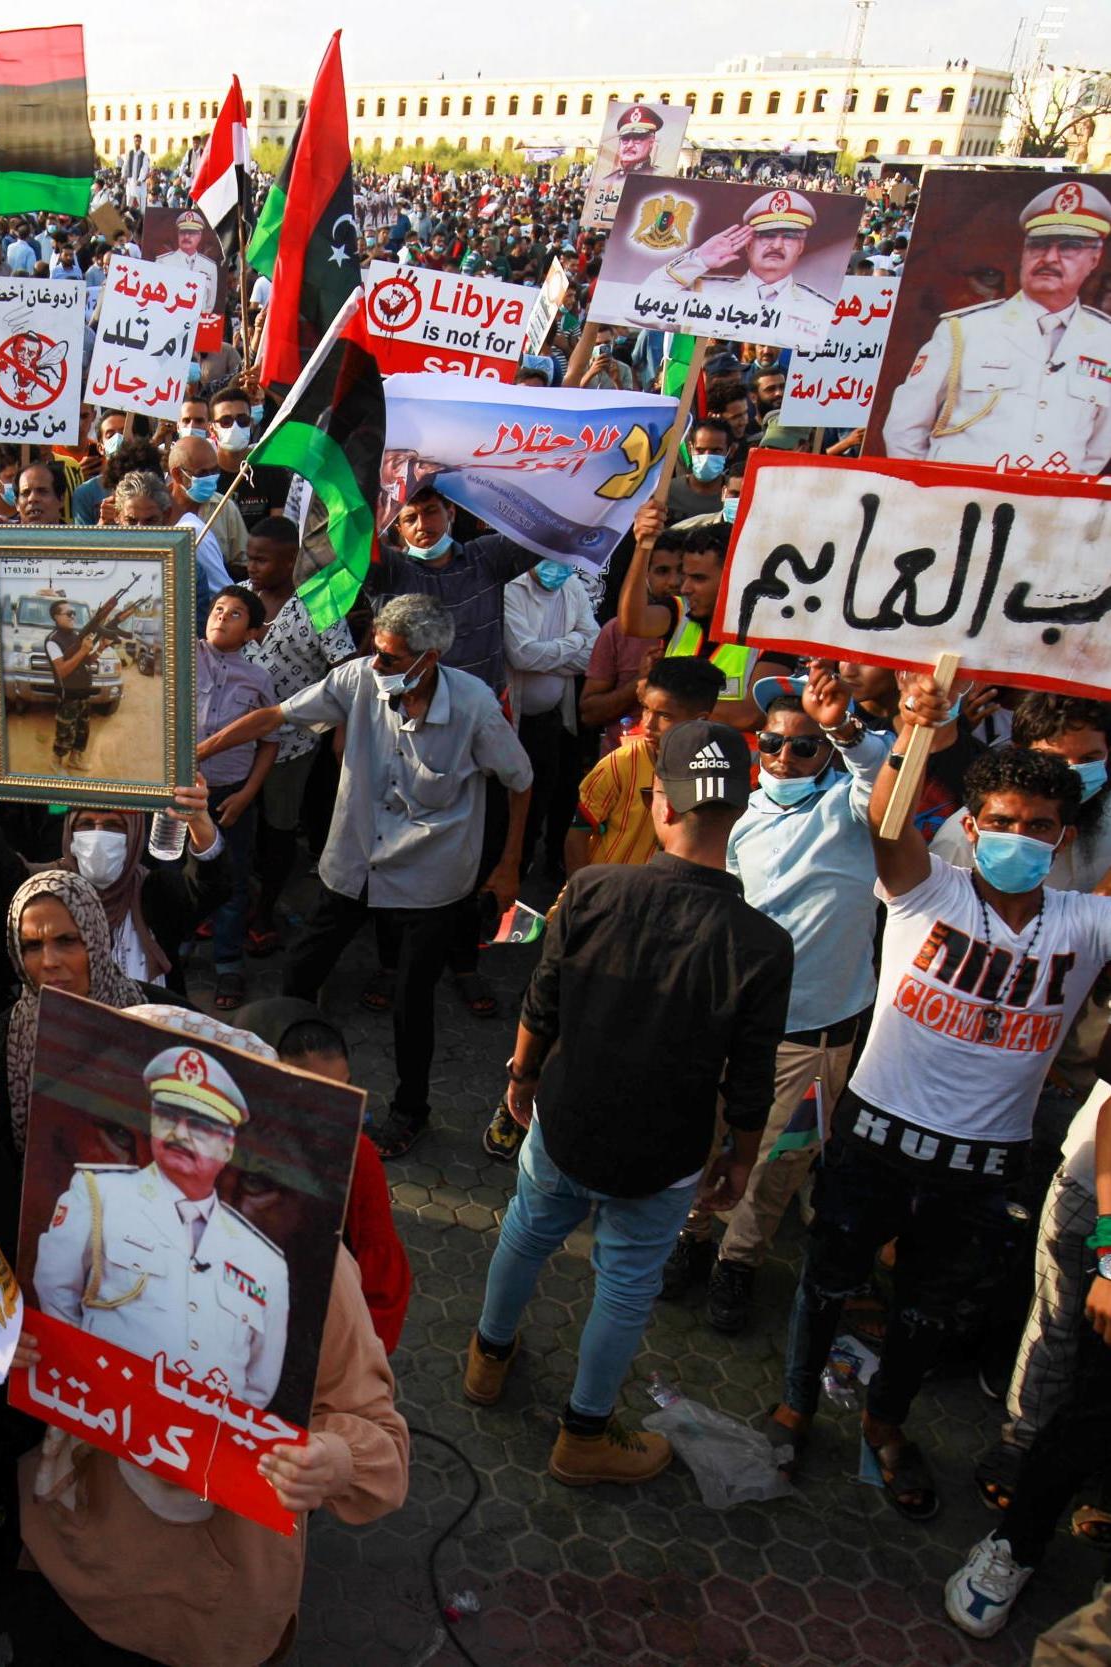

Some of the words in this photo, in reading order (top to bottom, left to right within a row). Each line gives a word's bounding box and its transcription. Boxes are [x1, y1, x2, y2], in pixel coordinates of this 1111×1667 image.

[26, 287, 79, 309] أردوغان
[113, 264, 199, 314] ترهونة
[429, 279, 525, 330] Libya
[633, 292, 679, 324] يومها
[682, 296, 712, 320] هذا
[714, 305, 783, 330] الأمجاد
[830, 288, 895, 327] ترهو
[149, 321, 192, 359] أم
[422, 320, 440, 341] is
[445, 331, 481, 349] not
[484, 331, 516, 355] for
[851, 341, 884, 364] العز
[423, 355, 501, 382] sale
[790, 373, 874, 408] والكرامة
[42, 415, 67, 439] من
[23, 566, 40, 575] 2014
[689, 758, 731, 770] adidas
[151, 1351, 301, 1451] جيشنا
[27, 1364, 195, 1472] كرامتنا
